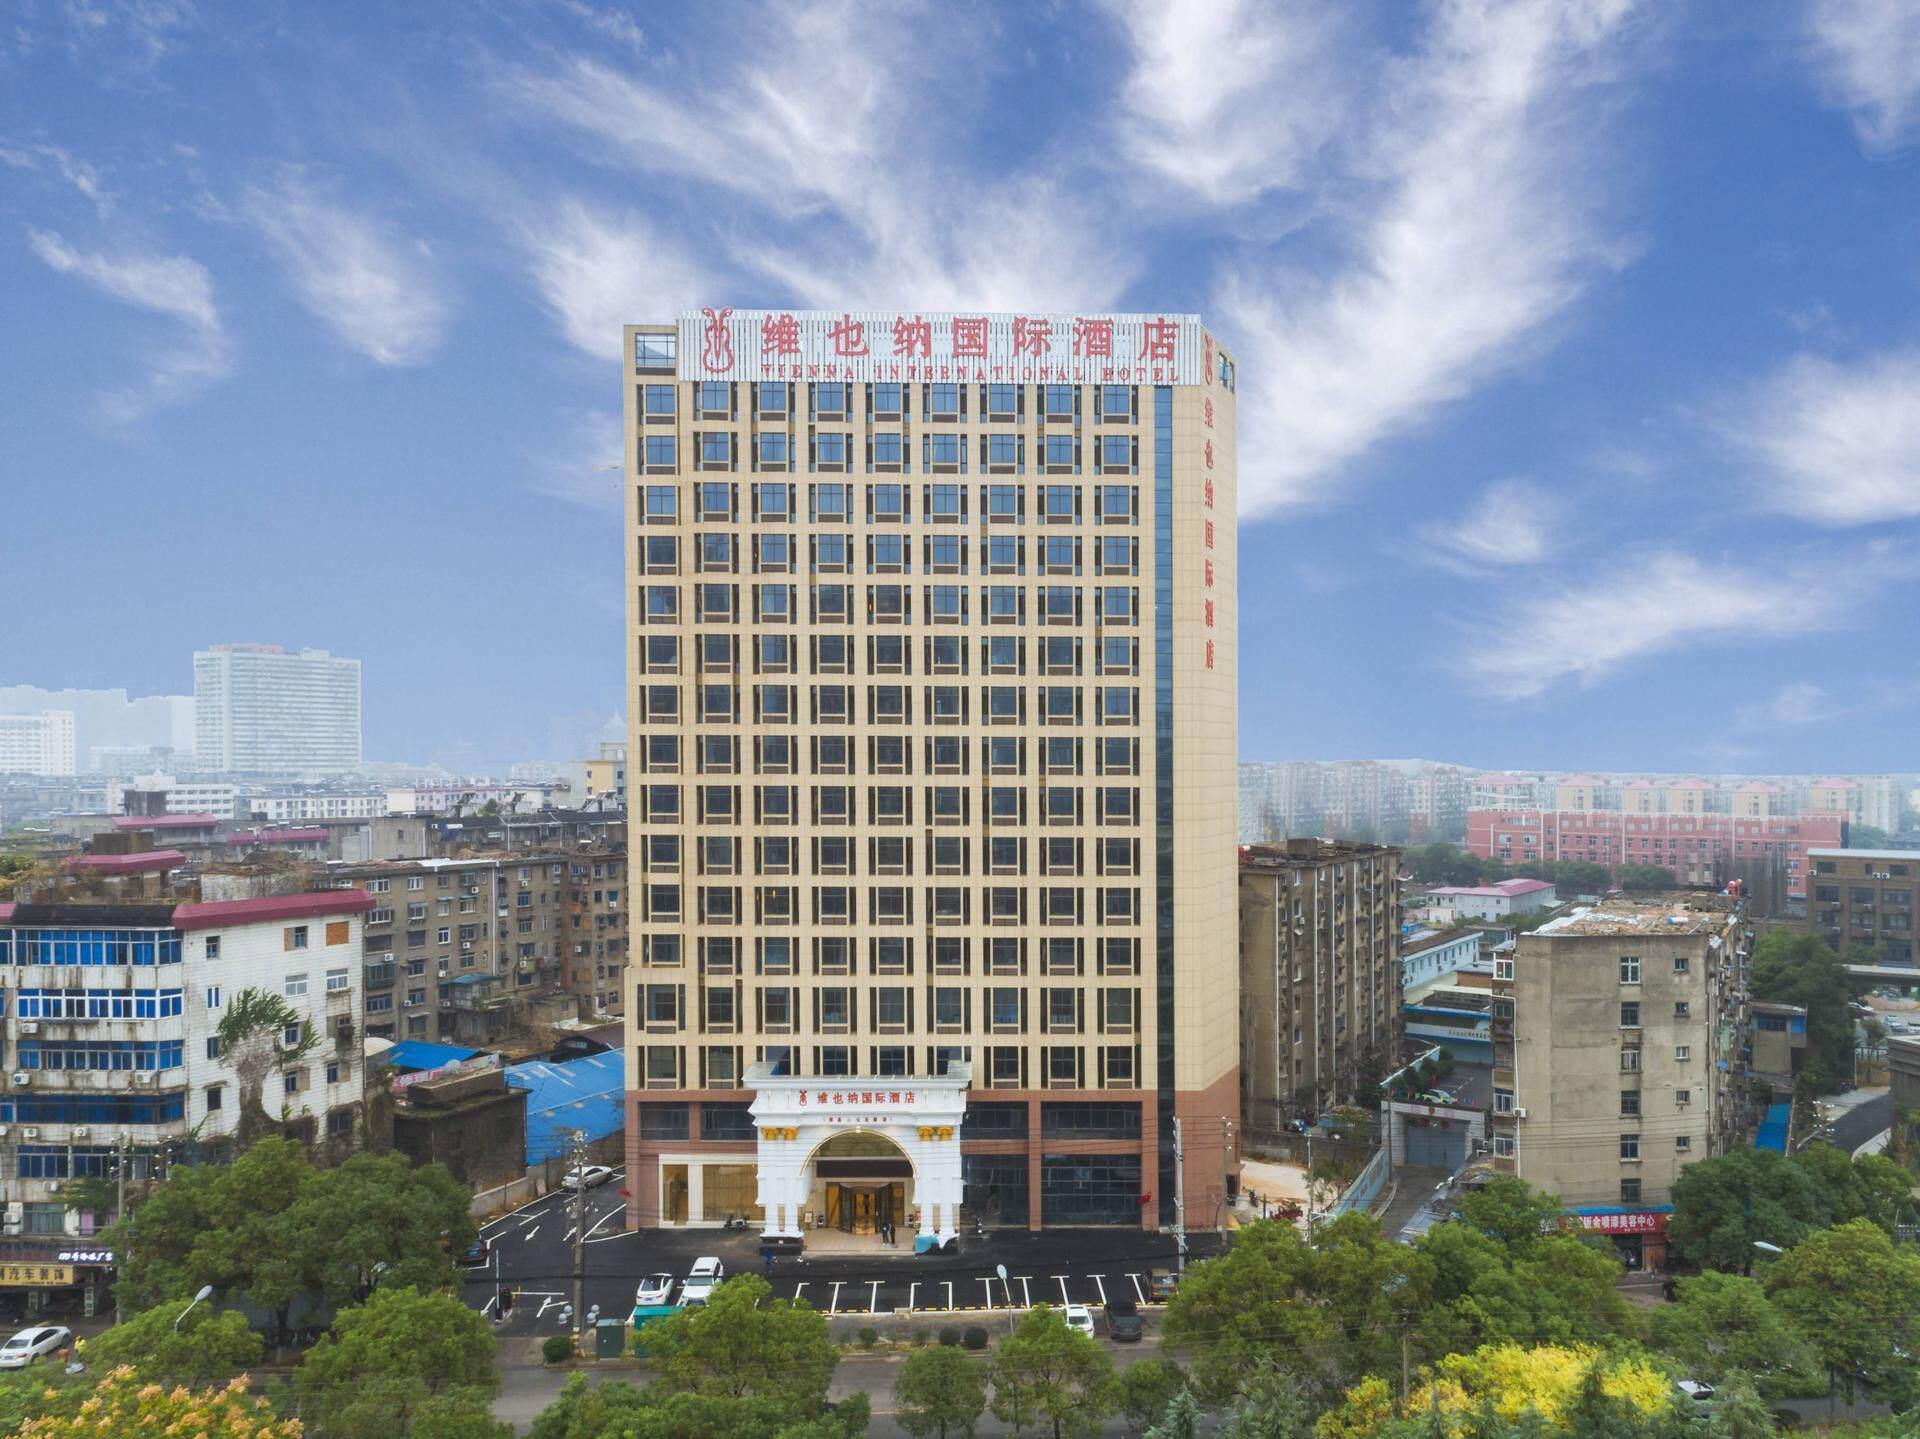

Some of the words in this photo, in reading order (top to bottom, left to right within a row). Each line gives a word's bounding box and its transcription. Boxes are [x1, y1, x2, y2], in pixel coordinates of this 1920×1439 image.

[761, 313, 1180, 361] 维也纳国际酒店
[761, 364, 855, 379] VIENNA
[875, 364, 1084, 381] INTERNATIONAL
[1102, 366, 1179, 381] HOTEL
[817, 1091, 915, 1104] 维也纳国际酒店
